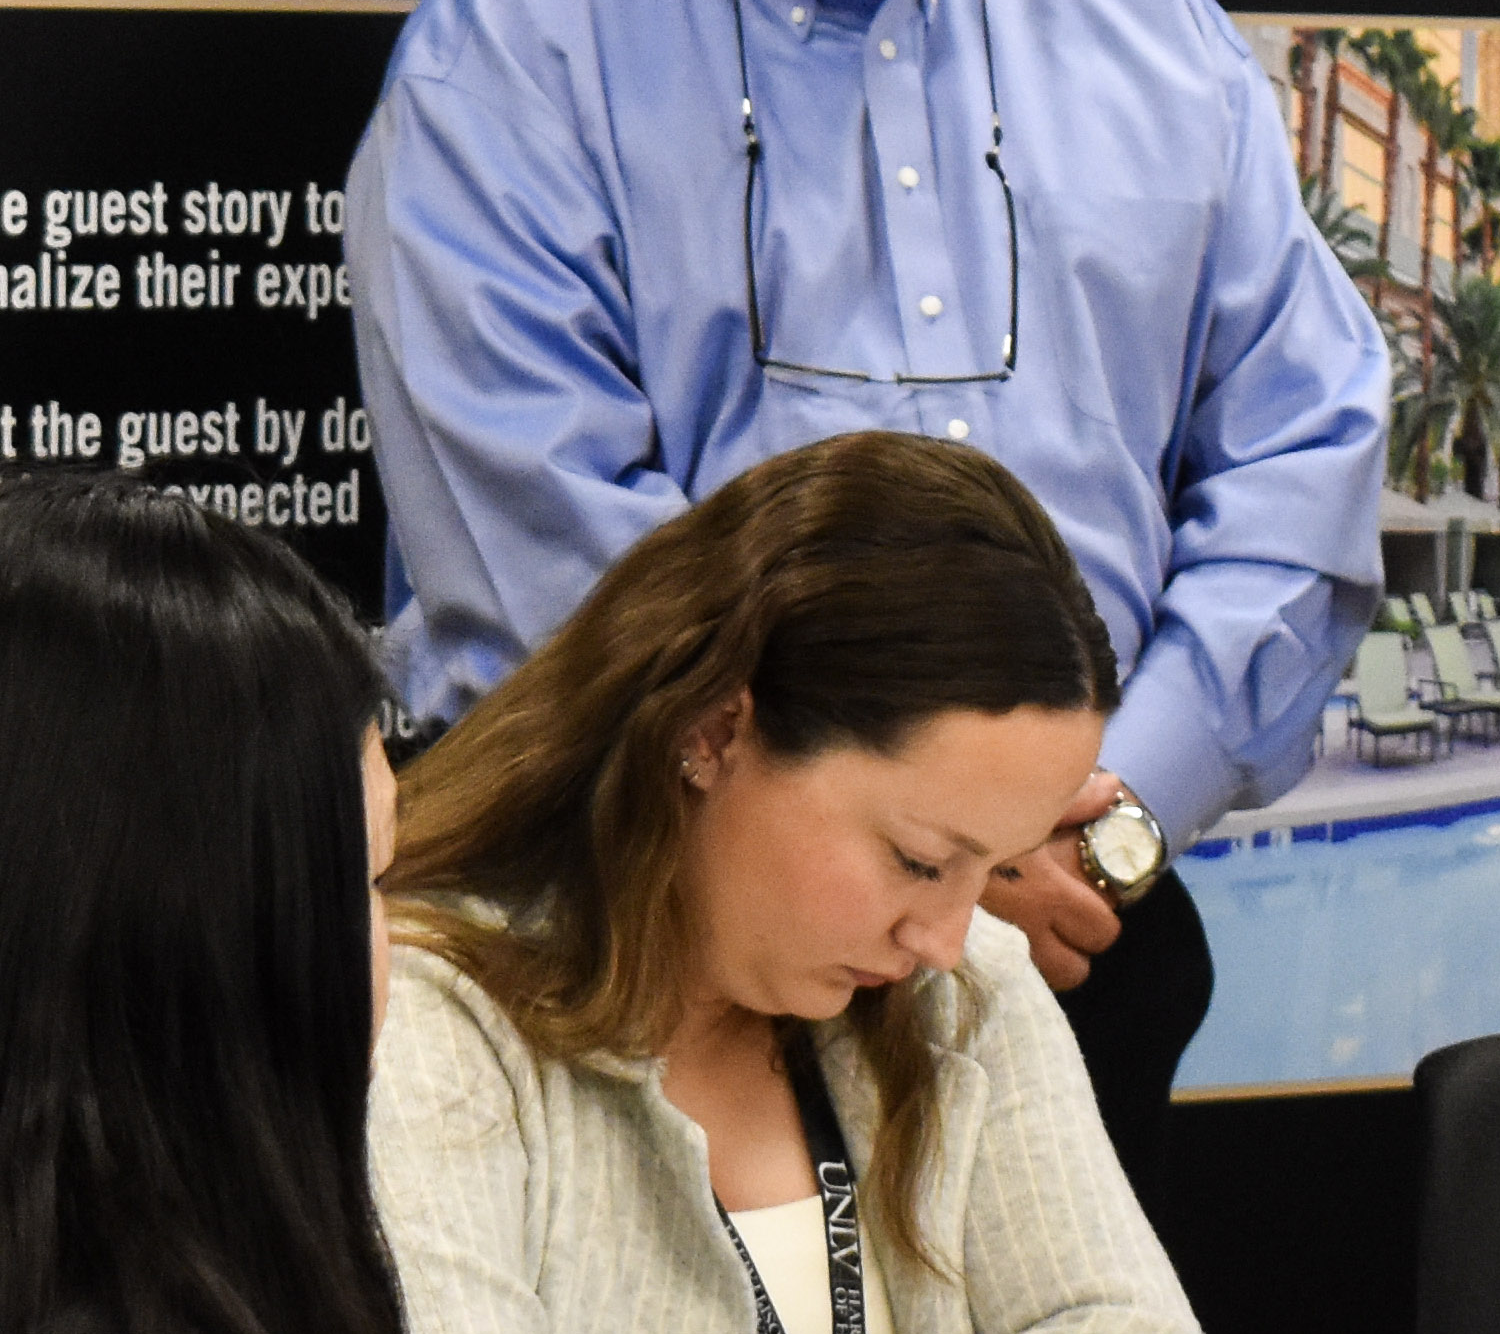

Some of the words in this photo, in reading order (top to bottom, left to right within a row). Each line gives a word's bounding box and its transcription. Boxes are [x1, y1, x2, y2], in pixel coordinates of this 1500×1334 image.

[43, 181, 169, 248] guest
[183, 181, 292, 248] story
[135, 251, 241, 309] their
[30, 400, 102, 459] the
[117, 401, 240, 471] guest
[256, 397, 306, 466] by
[818, 1161, 862, 1276] UNLV
[835, 1286, 849, 1316] OF
